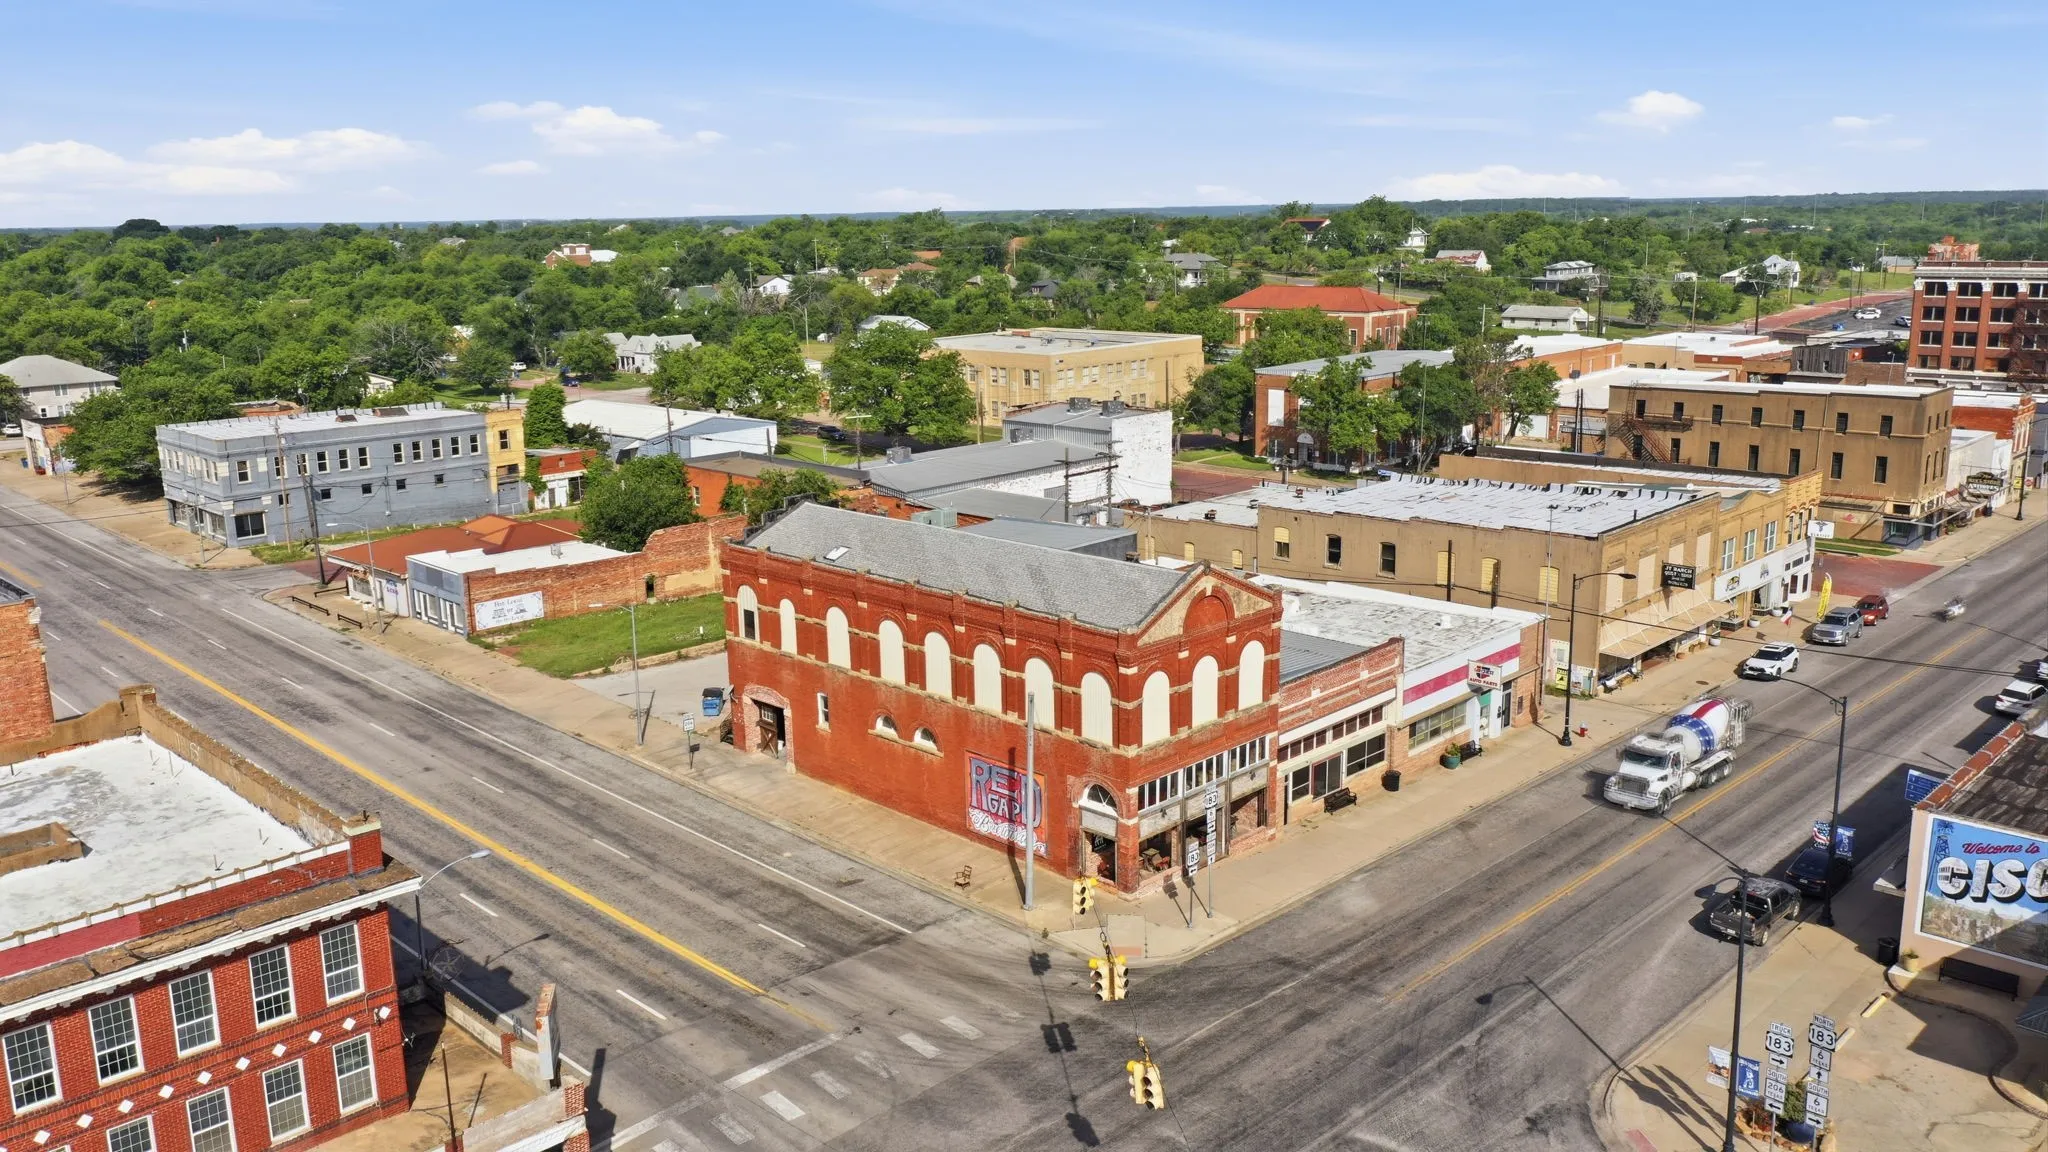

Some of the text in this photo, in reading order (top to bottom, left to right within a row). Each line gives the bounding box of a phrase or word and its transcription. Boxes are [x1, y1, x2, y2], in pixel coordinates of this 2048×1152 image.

[1483, 679, 1498, 687] PARTS
[969, 757, 1042, 828] RED
[987, 793, 1021, 821] GAP
[1961, 842, 2041, 855] Welcome to
[1188, 853, 1200, 864] 183
[1814, 1015, 1834, 1027] NORTH
[1771, 1023, 1791, 1035] TRUCK
[1811, 1028, 1833, 1046] 183
[1768, 1035, 1791, 1053] 183
[1817, 1049, 1824, 1060] 6
[1812, 1058, 1828, 1068] TEXAS
[1767, 1068, 1787, 1081] SOUTH
[1767, 1083, 1784, 1093] 206
[1808, 1083, 1828, 1095] SOUTH
[1767, 1091, 1783, 1100] TEXAS
[1813, 1097, 1820, 1107] 6
[1808, 1104, 1825, 1114] TEXAS
